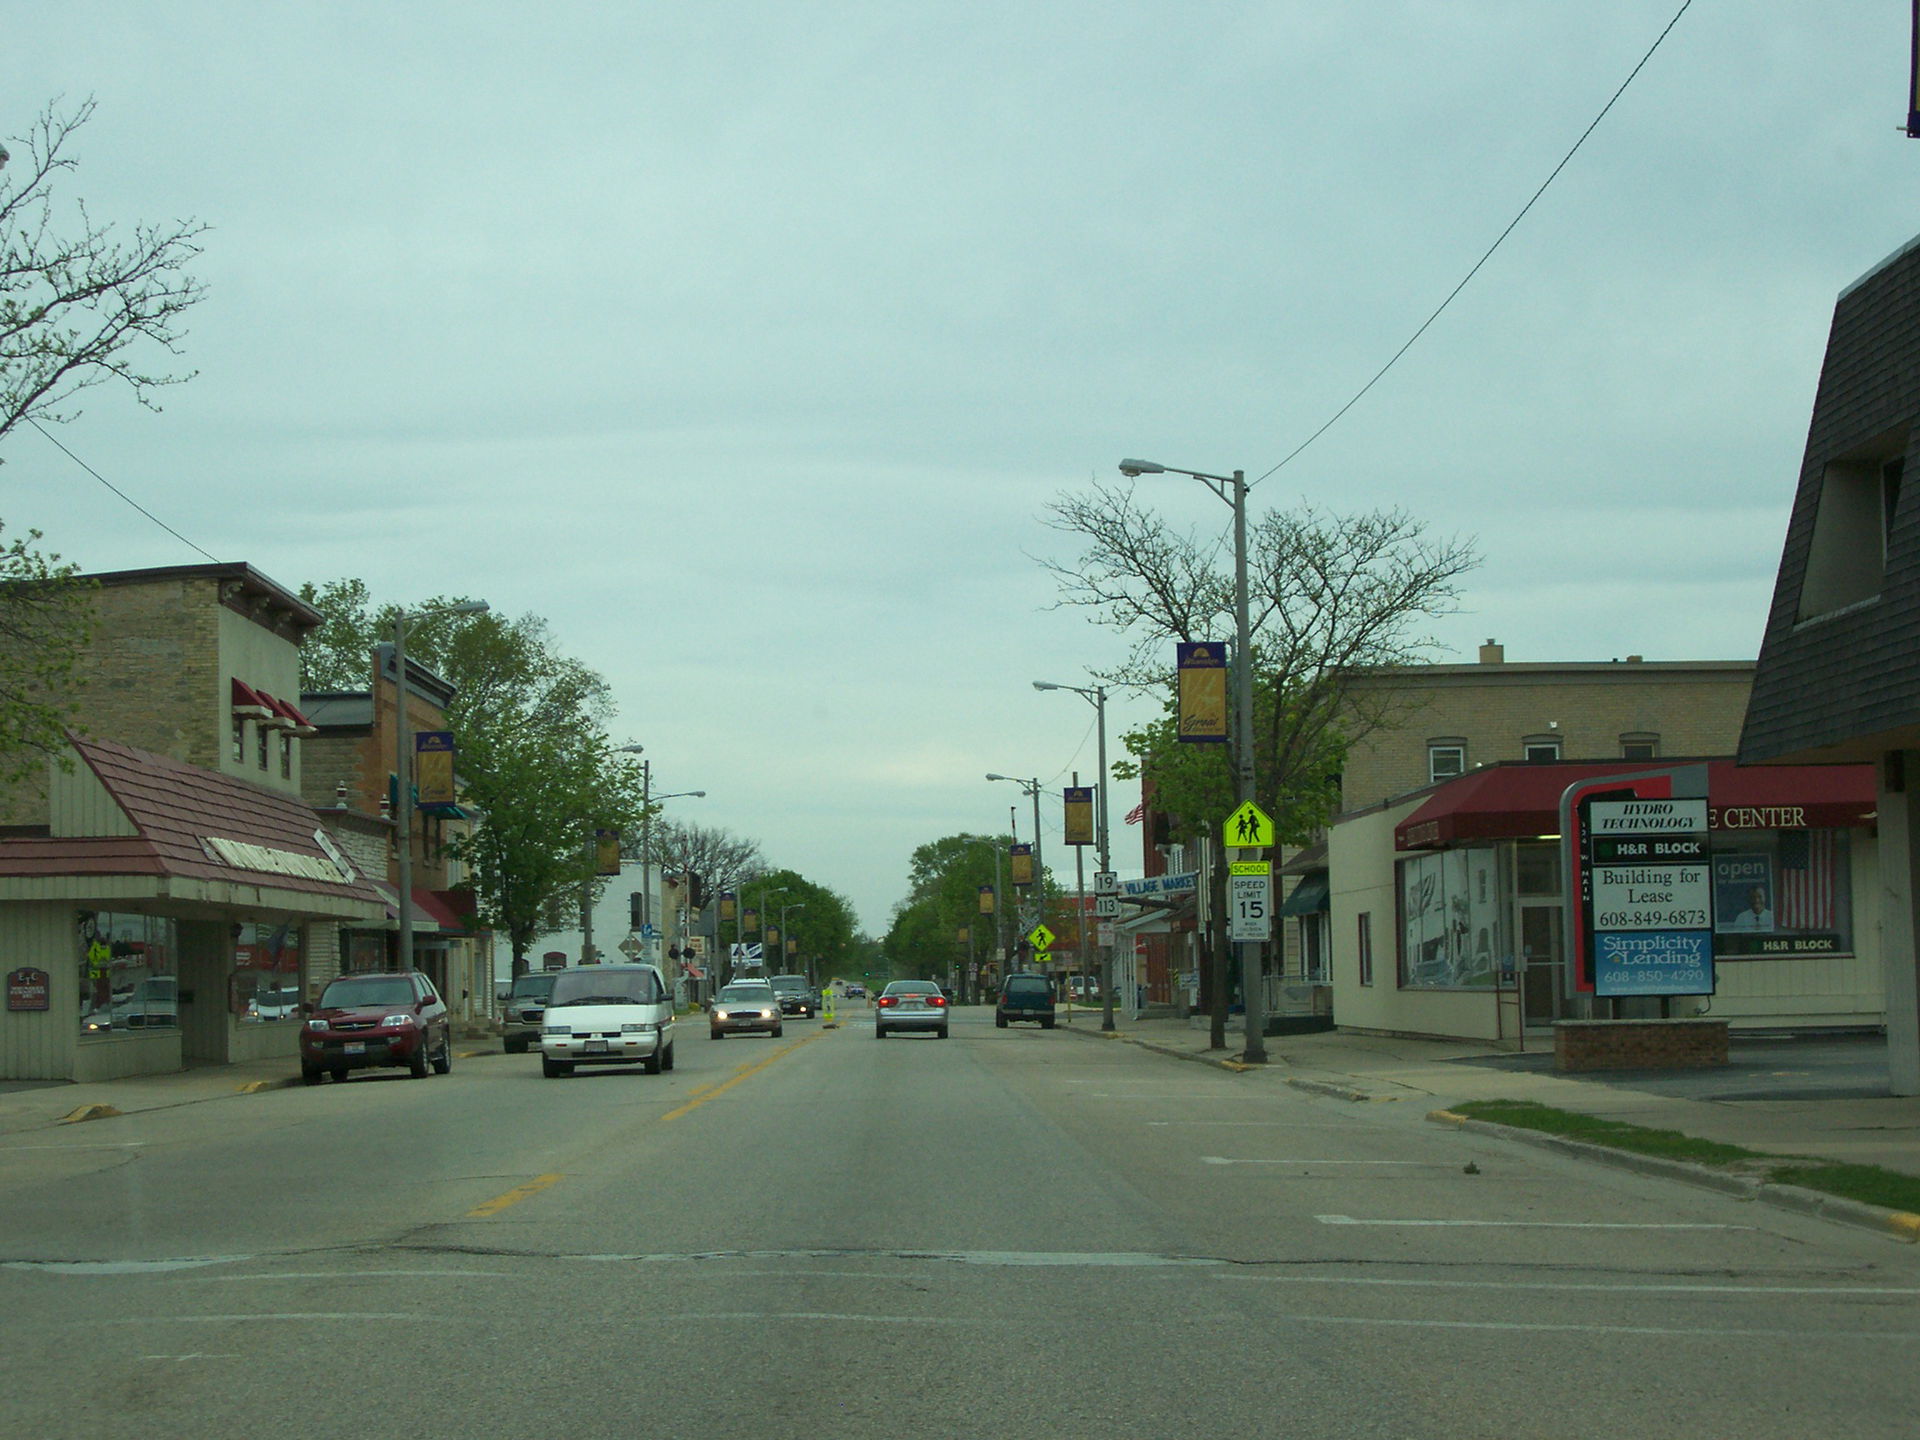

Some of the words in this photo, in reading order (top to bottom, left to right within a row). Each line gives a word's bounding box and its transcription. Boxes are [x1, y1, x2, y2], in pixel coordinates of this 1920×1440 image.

[1624, 804, 1673, 815] HYDRO
[1602, 817, 1696, 830] TECHNOLOGY
[1724, 807, 1807, 829] CENTER
[1617, 843, 1648, 855] H&R
[1655, 842, 1701, 854] BLOCK
[1233, 864, 1267, 873] SCHOOL
[1718, 861, 1764, 879] open
[1100, 877, 1113, 889] 19
[1603, 869, 1673, 887] Building
[1679, 868, 1701, 883] for
[1125, 880, 1159, 895] VILLAGE
[1162, 875, 1195, 889] MARKET
[1234, 881, 1266, 889] SPEED
[1237, 890, 1262, 899] LIMIT
[1628, 889, 1673, 903] Lease
[1099, 900, 1115, 912] 113
[1240, 901, 1264, 919] 15
[1600, 910, 1706, 927] 608-849-6873
[1603, 935, 1702, 953] Simplicity
[1763, 941, 1789, 951] H&R
[1795, 939, 1833, 950] BLOCK
[1623, 950, 1701, 968] Lending
[1604, 970, 1704, 983] 608-850-4290
